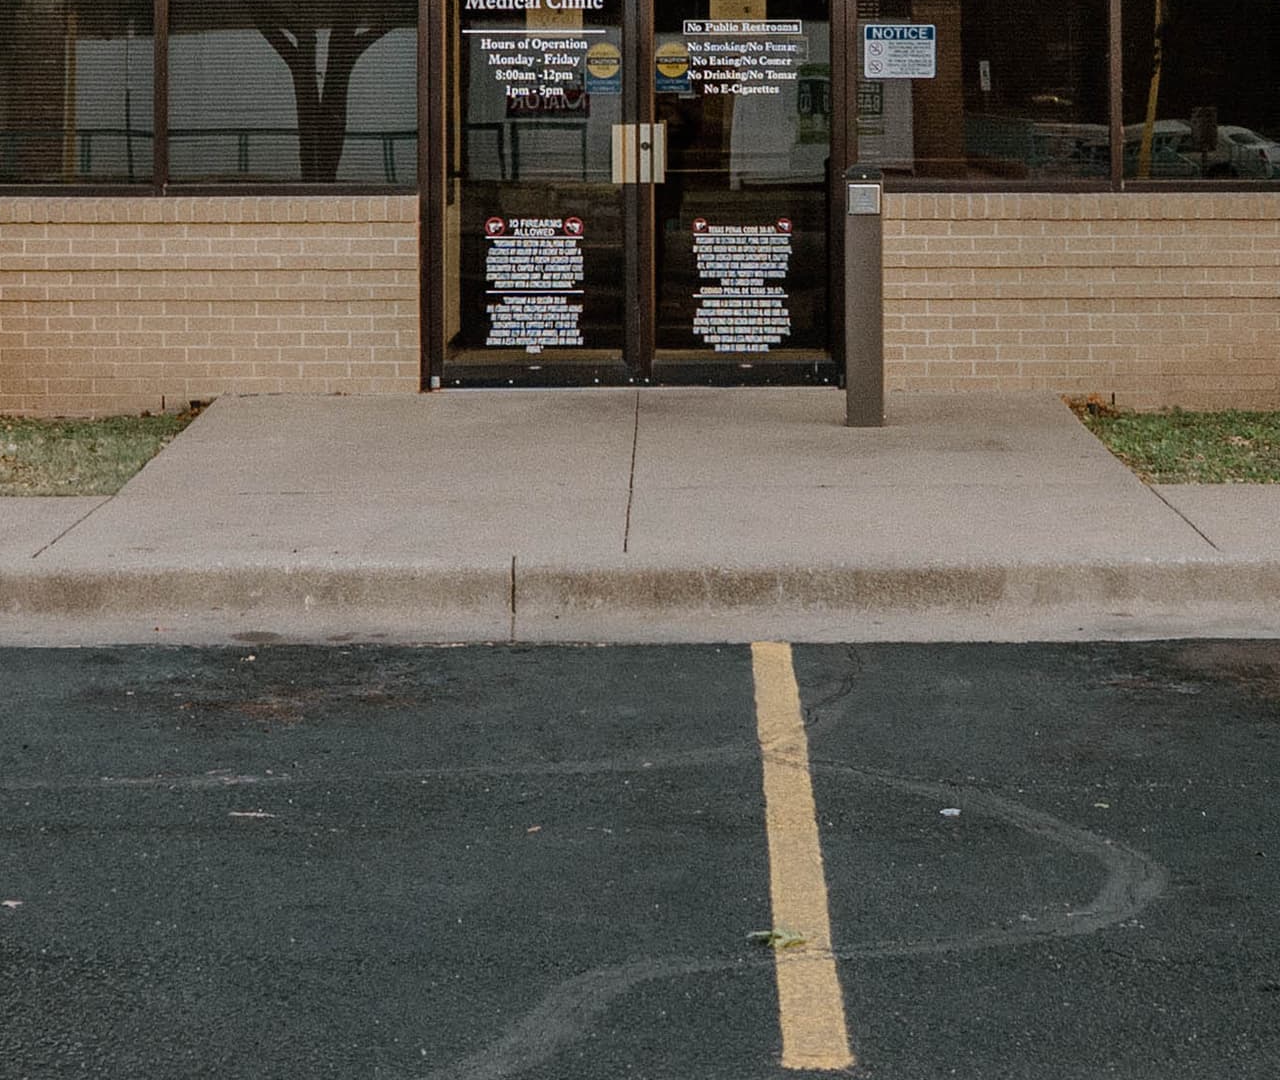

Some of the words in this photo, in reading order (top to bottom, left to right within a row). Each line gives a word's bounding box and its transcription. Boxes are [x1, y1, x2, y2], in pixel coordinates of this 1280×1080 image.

[687, 23, 702, 32] No
[704, 23, 739, 32] Public
[742, 23, 798, 32] Restrooms
[872, 27, 929, 39] NOTICE
[480, 38, 515, 50] Hours
[517, 38, 530, 50] of
[531, 38, 588, 51] Operation
[687, 42, 702, 52] No
[488, 54, 535, 66] Monday
[544, 54, 580, 66] Friday
[692, 56, 707, 66] No
[495, 70, 536, 81] 8:00am
[687, 70, 702, 80] No
[765, 70, 797, 80] Tomar
[505, 85, 529, 97] 1pm
[539, 85, 564, 97] 5pm
[704, 84, 719, 94] No
[513, 228, 556, 237] ALLOWED
